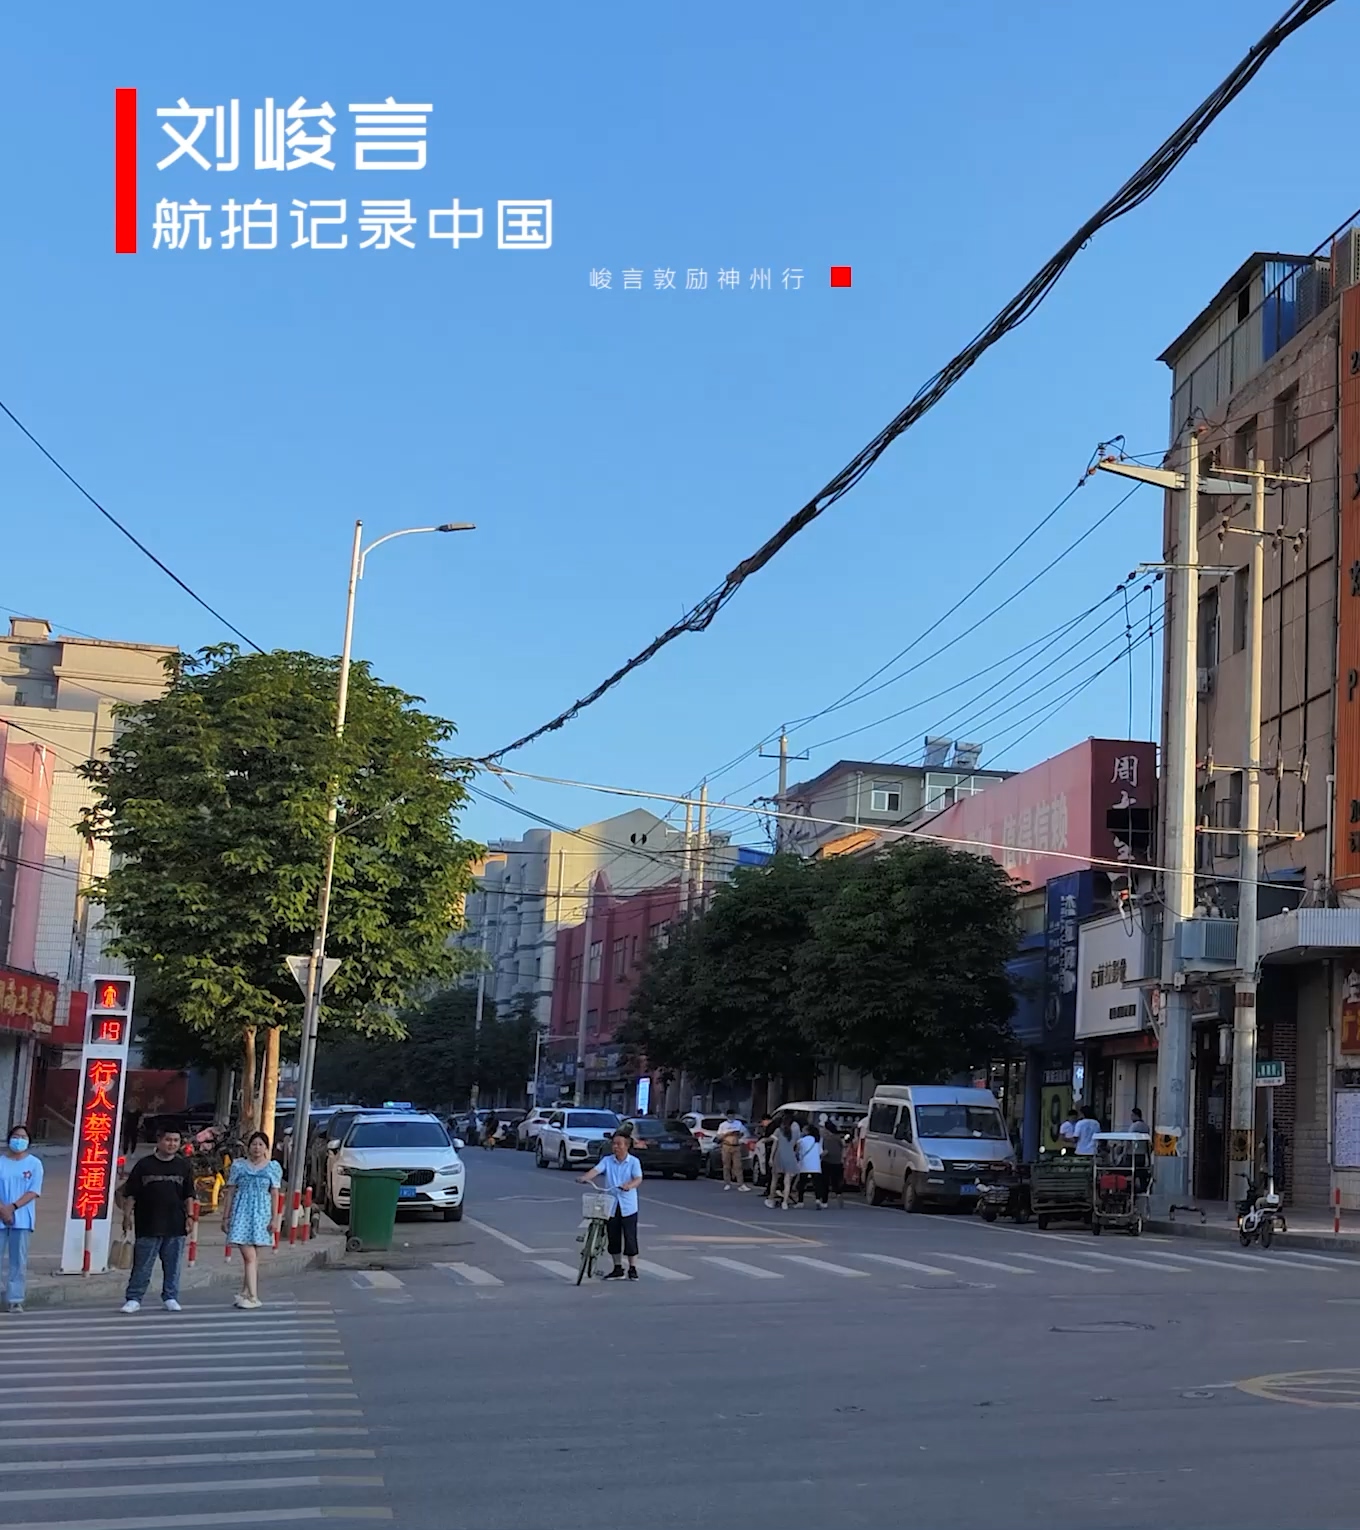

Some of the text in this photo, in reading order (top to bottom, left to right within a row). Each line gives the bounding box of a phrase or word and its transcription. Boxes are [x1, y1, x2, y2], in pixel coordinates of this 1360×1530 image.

[100, 1021, 120, 1041] 19
[75, 1060, 118, 1218] 行人禁止通行
